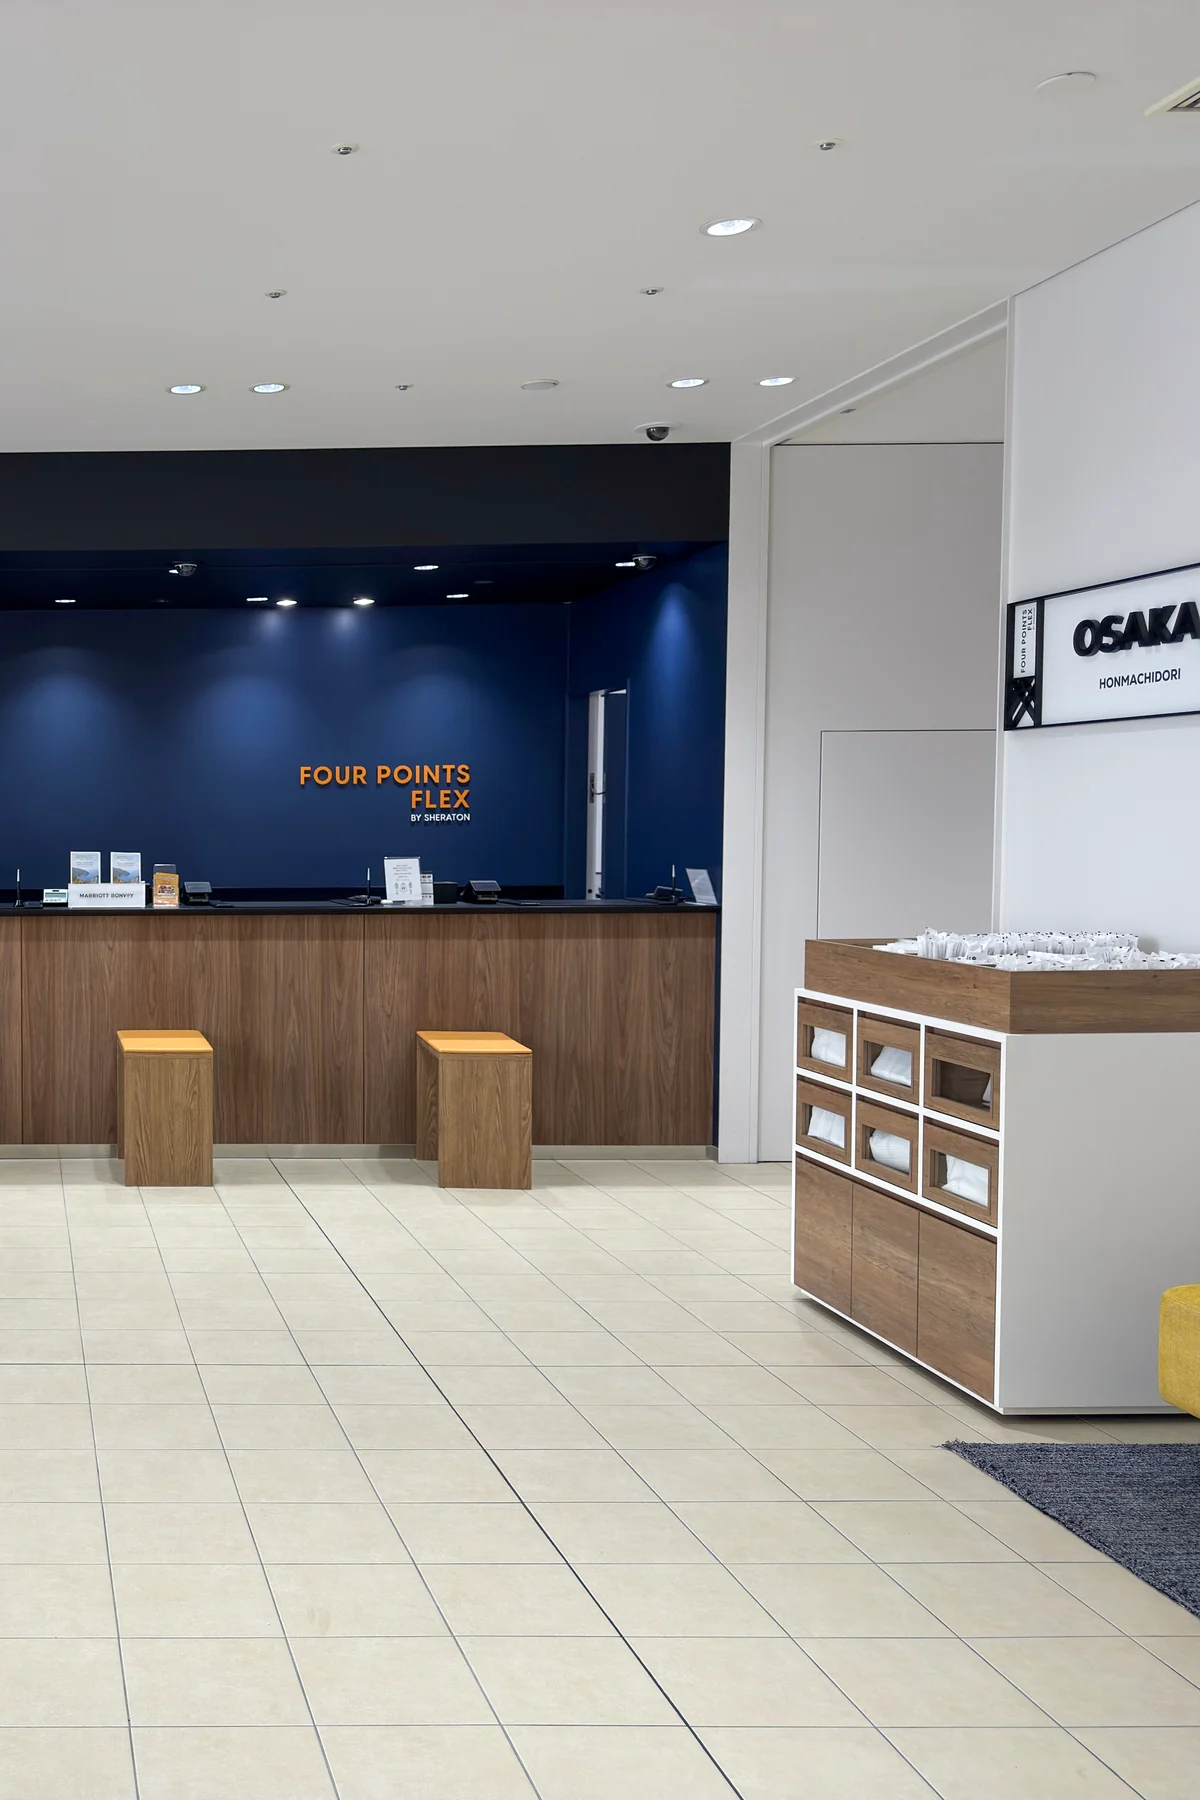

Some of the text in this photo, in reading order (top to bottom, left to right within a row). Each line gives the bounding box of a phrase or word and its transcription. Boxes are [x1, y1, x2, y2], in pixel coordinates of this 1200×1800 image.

[1073, 601, 1200, 657] OSAKA
[1099, 667, 1181, 690] HONMACHIDORI
[299, 764, 471, 785] FOUR POINTS
[410, 789, 470, 809] FLEX
[410, 813, 471, 822] BY SHERATON
